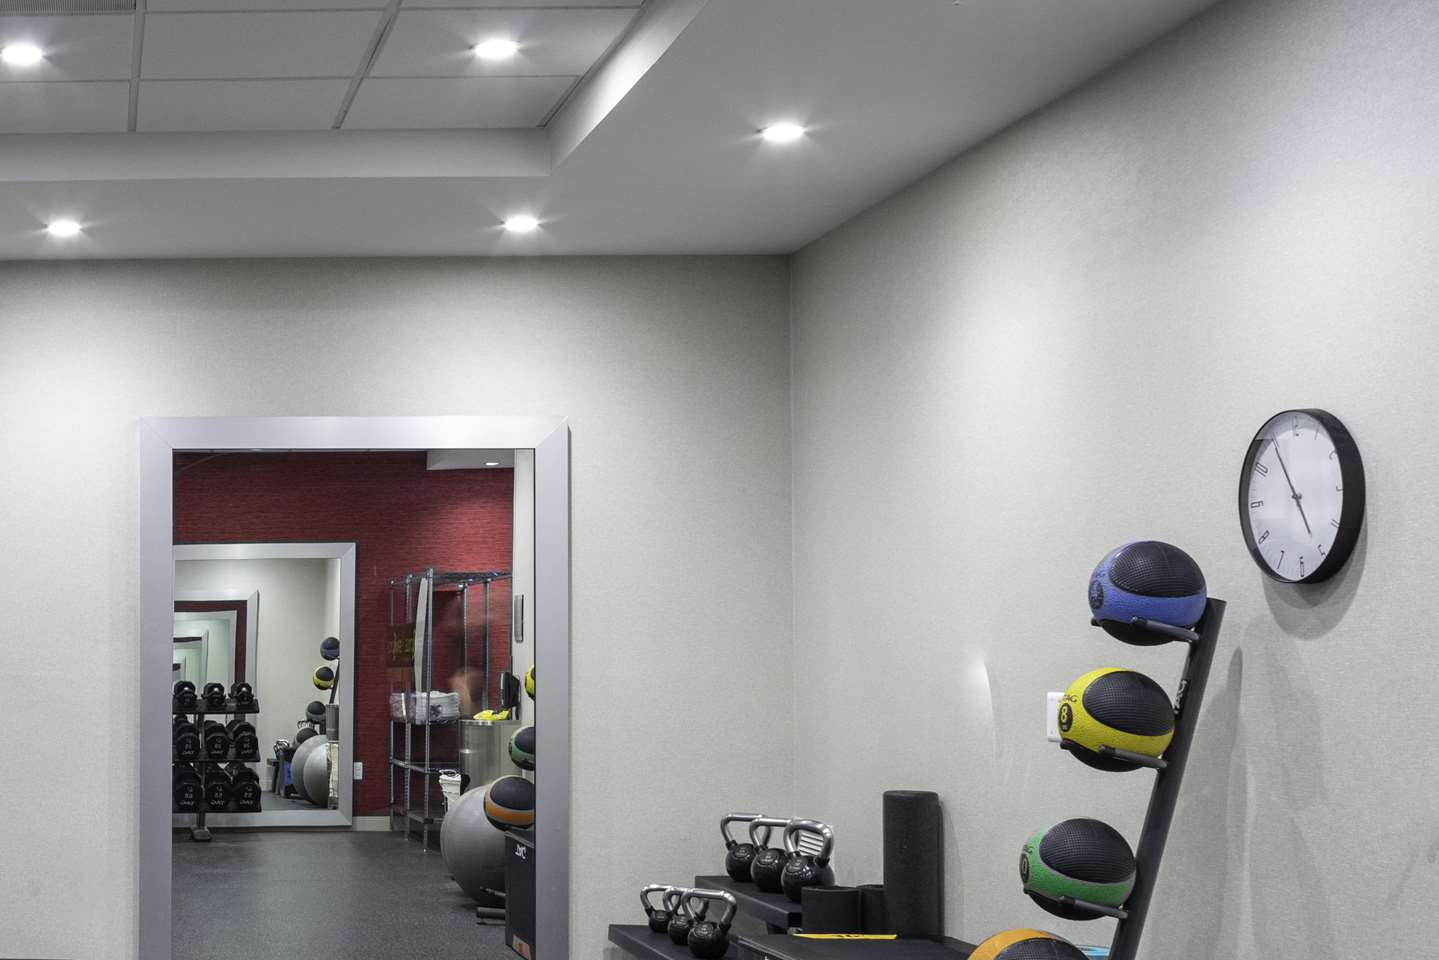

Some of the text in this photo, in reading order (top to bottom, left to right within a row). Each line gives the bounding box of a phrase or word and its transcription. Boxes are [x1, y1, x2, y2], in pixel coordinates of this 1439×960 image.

[1255, 462, 1269, 477] 10
[1250, 500, 1264, 509] 9
[1258, 530, 1270, 545] 8
[1060, 705, 1068, 724] 8
